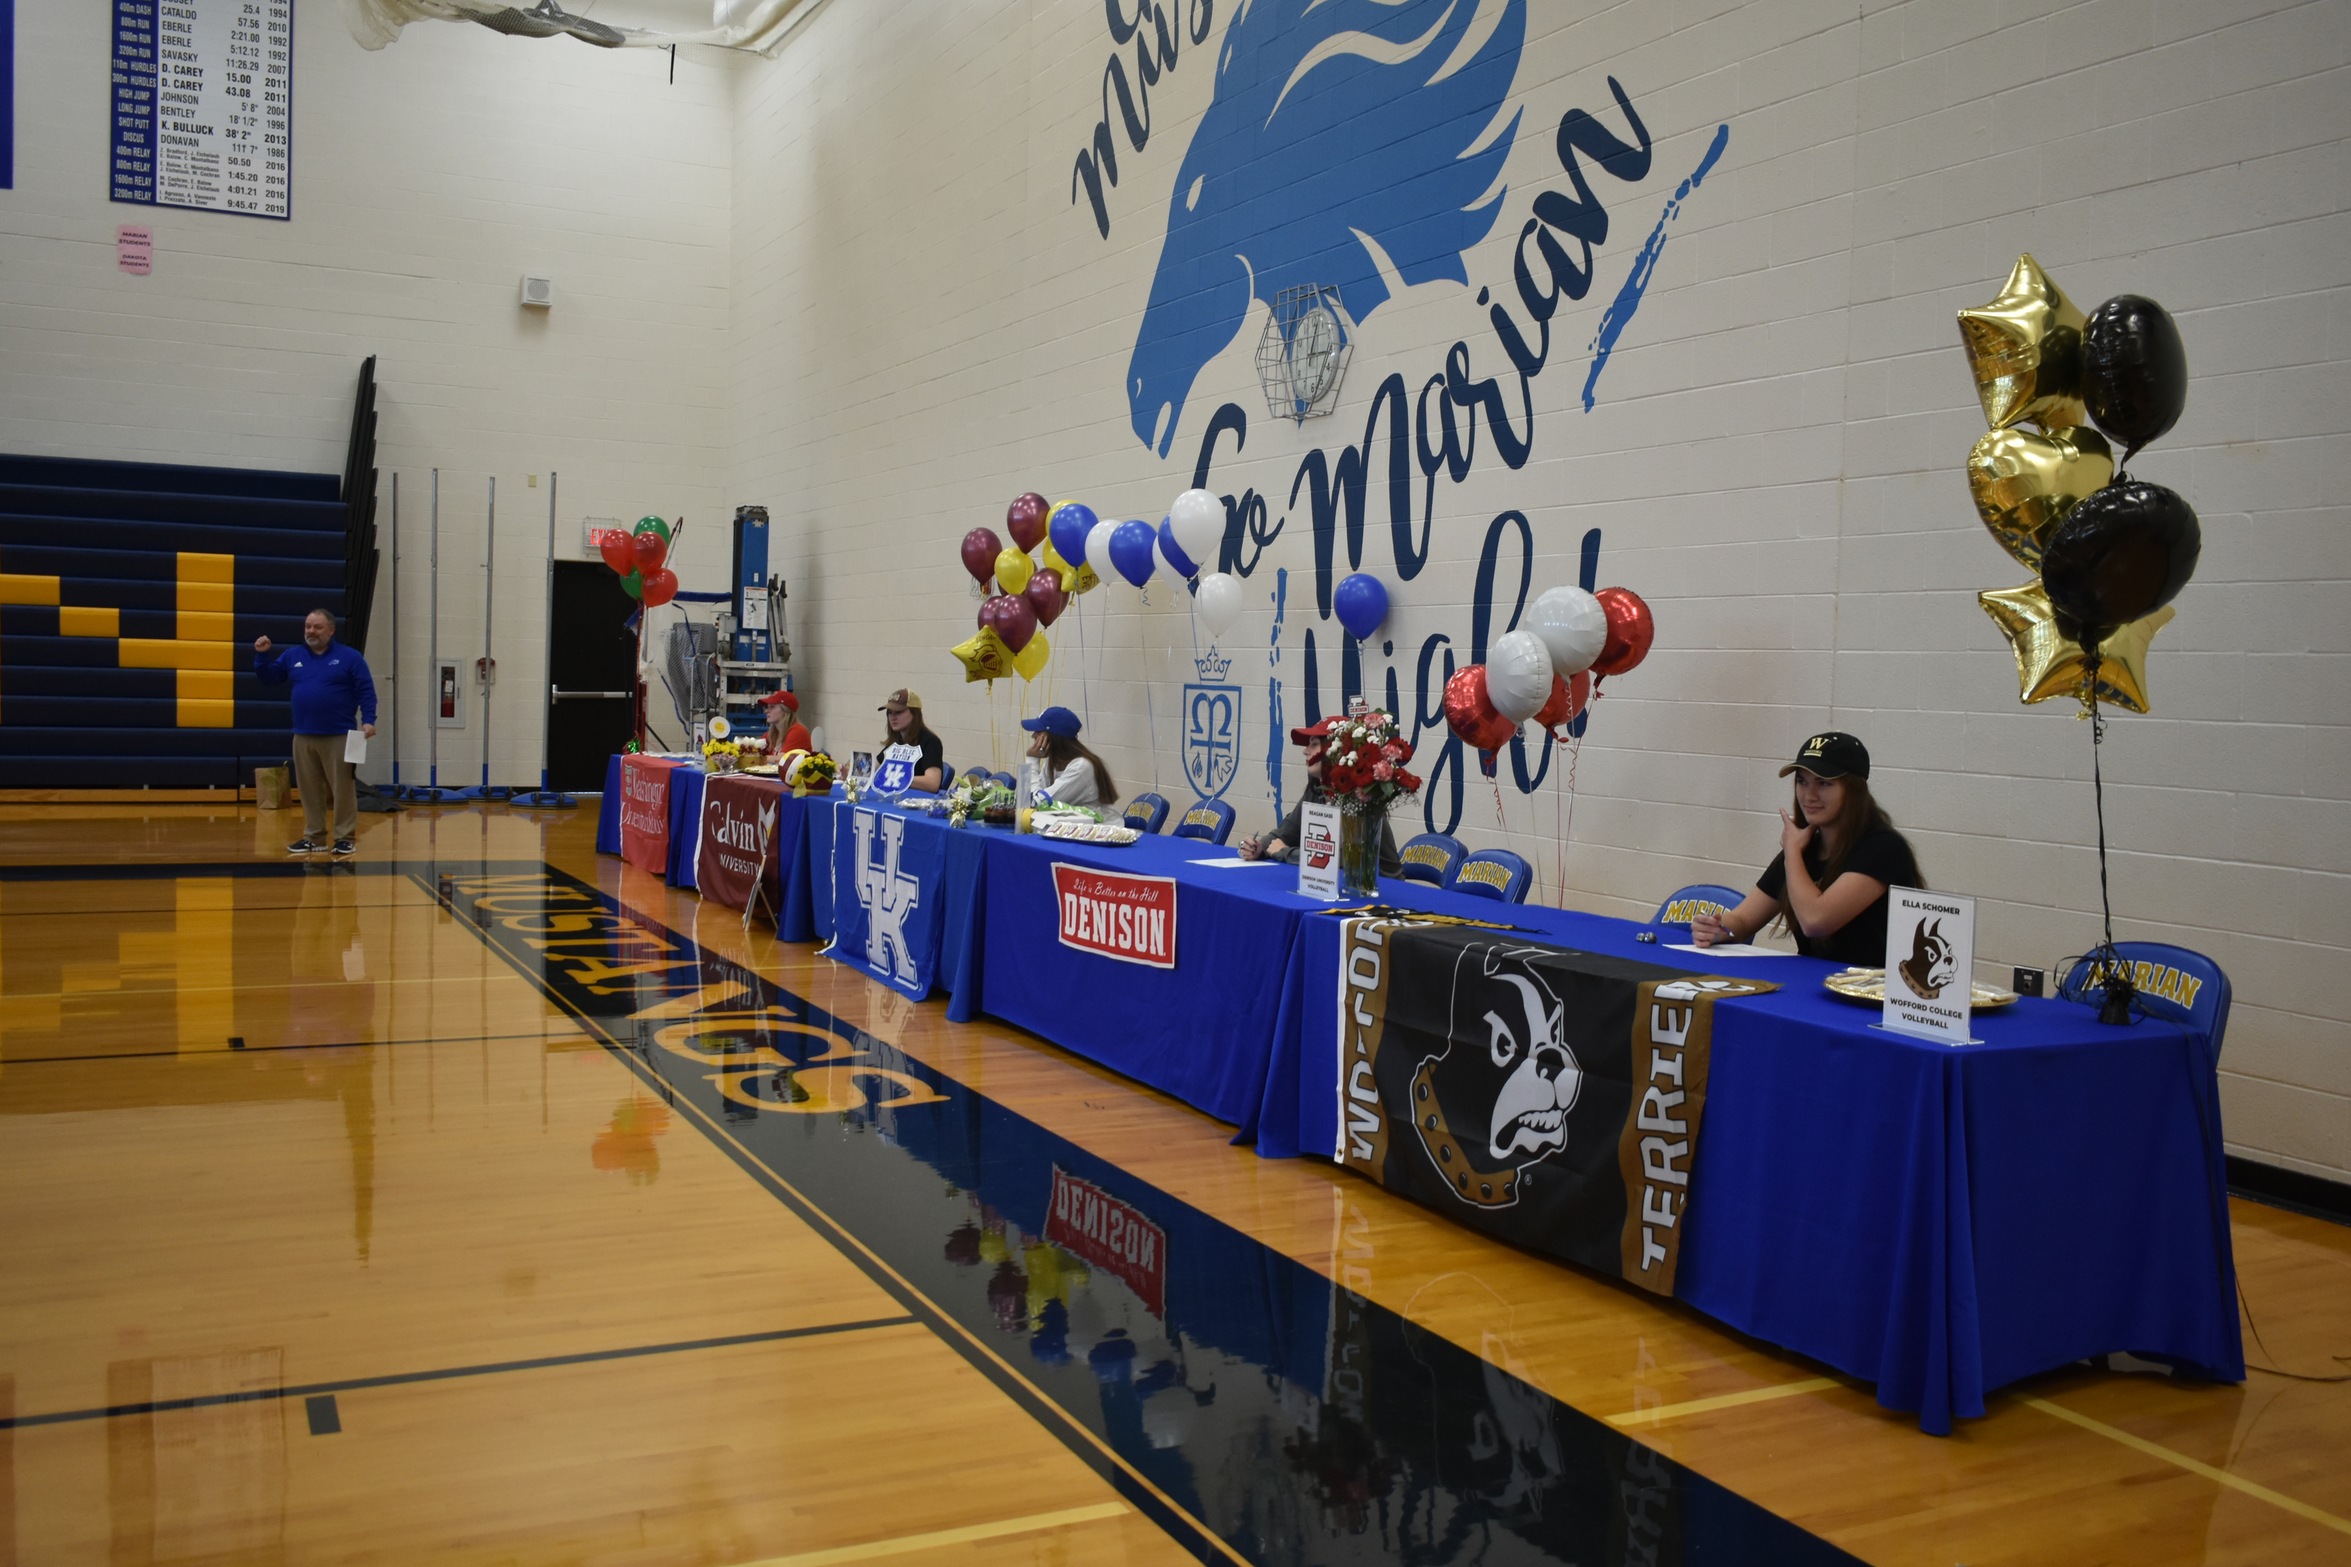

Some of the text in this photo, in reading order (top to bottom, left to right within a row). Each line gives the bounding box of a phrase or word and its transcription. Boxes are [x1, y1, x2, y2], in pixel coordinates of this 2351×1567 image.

[136, 4, 151, 16] DASH
[162, 6, 197, 20] CATALDO
[238, 18, 259, 29] 57.56
[268, 22, 287, 33] 2010
[244, 4, 287, 19] 25.4 1994
[138, 19, 150, 30] RUN
[162, 21, 192, 34] EBERLE
[231, 31, 260, 43] 2:21.00
[269, 36, 287, 47] 1992
[139, 33, 151, 44] RUN
[162, 35, 192, 48] EBERLE
[231, 45, 259, 58] 5:12.12
[268, 51, 287, 61] 1992
[139, 48, 151, 59] RUN
[162, 49, 198, 63] SAVASKY
[226, 59, 259, 71] 11:26.29
[268, 64, 286, 75] 2007
[131, 61, 157, 74] HURDLES
[162, 64, 171, 73] D.
[174, 65, 204, 78] CAREY
[226, 73, 252, 84] 15.00
[265, 78, 287, 89] 2011
[131, 75, 156, 88] HURDLES
[162, 78, 171, 88] D.
[174, 80, 204, 92] CAREY
[226, 87, 251, 98] 43.08
[265, 92, 286, 103] 2011
[119, 88, 133, 99] HIGH
[134, 90, 150, 101] JUMP
[161, 92, 199, 105] JOHNSON
[267, 106, 286, 116] 2004
[118, 103, 134, 114] LONG
[134, 105, 151, 116] JUMP
[161, 106, 196, 119] BENTLEY
[267, 120, 286, 131] 1996
[118, 117, 134, 128] SHOT
[135, 119, 150, 130] PUTT
[162, 120, 170, 131] K.
[173, 121, 214, 136] BULLUCK
[264, 134, 287, 145] 2013
[124, 132, 144, 144] DISCUS
[161, 134, 200, 148] DONAVAN
[267, 148, 285, 158] 1986
[133, 147, 151, 158] RELAY
[133, 161, 151, 172] RELAY
[228, 157, 285, 171] 50.50 2016
[134, 176, 152, 187] RELAY
[228, 171, 285, 185] 1:45.20 2016
[134, 190, 152, 201] RELAY
[228, 186, 257, 196] 4:01.21
[266, 190, 285, 200] 2016
[228, 200, 285, 214] 9:45.47 2019
[119, 239, 151, 247] STUDENTS
[1289, 75, 1652, 622] Marian
[1810, 737, 1829, 749] W
[1306, 841, 1333, 852] DENISON
[720, 854, 759, 877] NIVERSITY
[1401, 845, 1451, 873] MARIAN
[1456, 861, 1513, 893] MARIAN
[853, 806, 919, 990] UK
[1074, 878, 1087, 895] Life
[1094, 882, 1116, 897] Better
[1140, 887, 1159, 902] Hill
[1902, 900, 1960, 916] ELLA SCHOMER
[1065, 892, 1165, 957] DENISON
[1890, 997, 1963, 1020] WOFFORD COLLEGE
[1902, 1012, 1949, 1030] VOLLEYBALL
